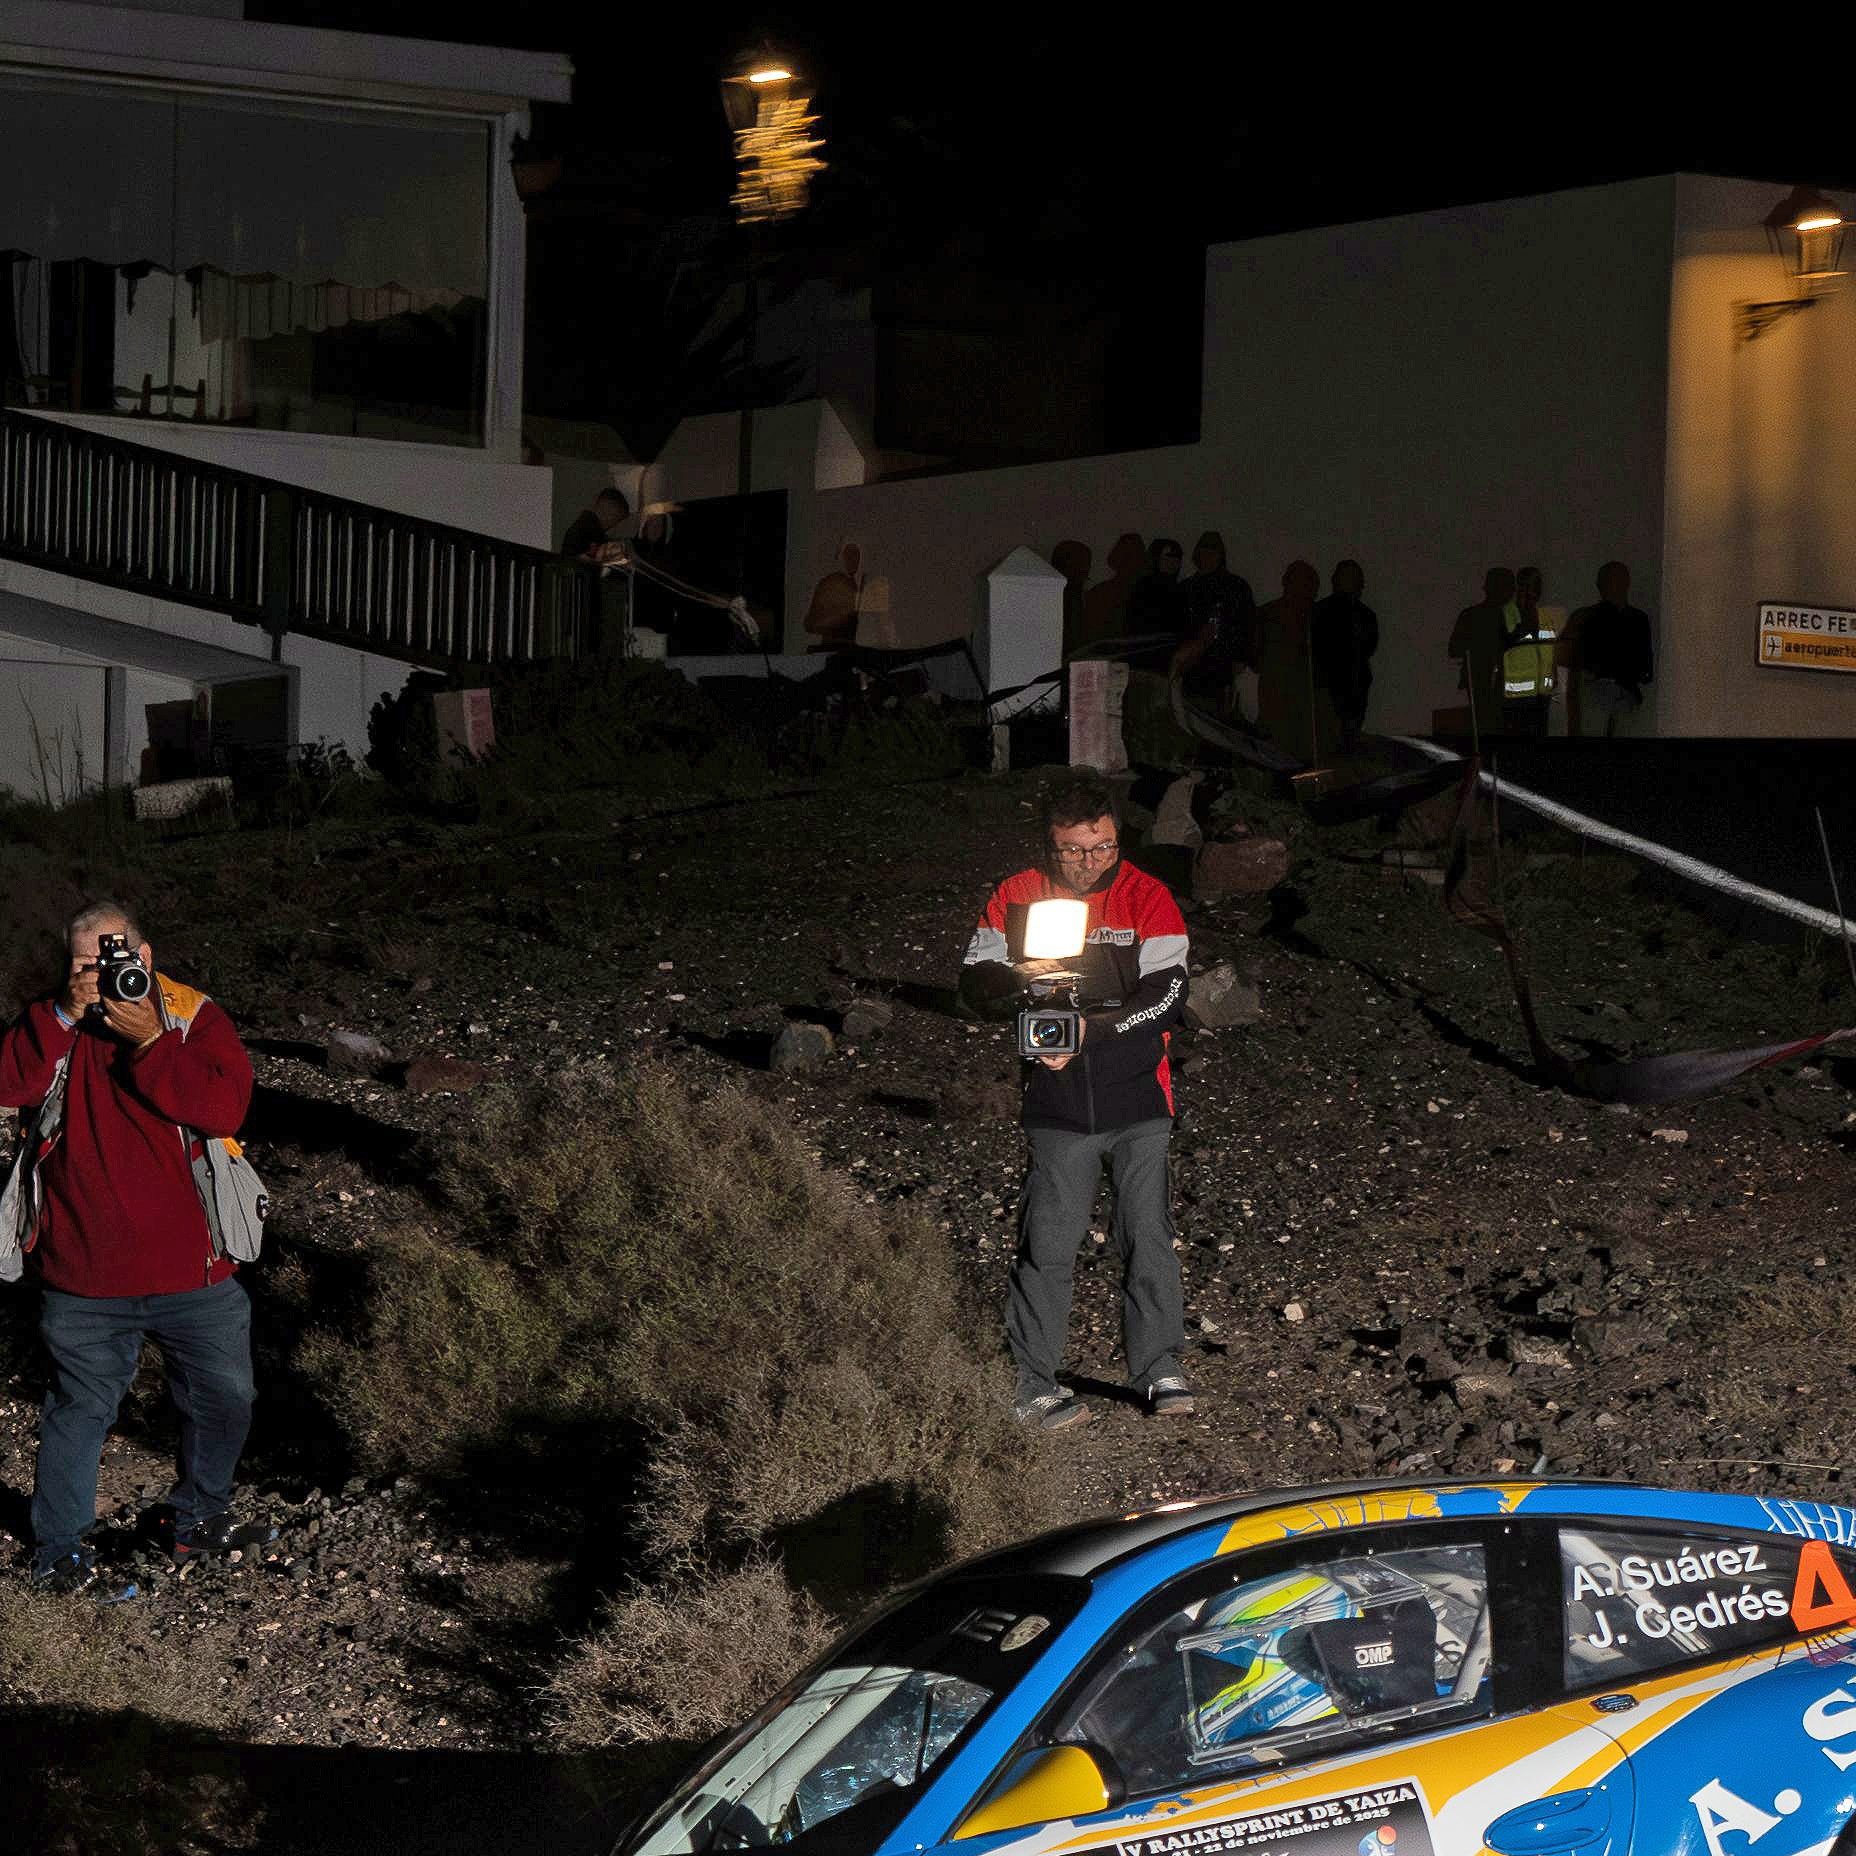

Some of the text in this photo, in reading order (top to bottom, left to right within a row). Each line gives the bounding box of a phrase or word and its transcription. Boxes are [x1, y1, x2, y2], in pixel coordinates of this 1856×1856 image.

[1573, 1544, 1767, 1601] A. Suárez
[1588, 1585, 1790, 1649] J. Cedrés
[1355, 1645, 1393, 1666] OMP
[1147, 1811, 1305, 1856] RALLYSPRINT
[1309, 1804, 1344, 1821] DE
[1344, 1787, 1418, 1814] YAIZA
[1204, 1842, 1224, 1854] 22
[1228, 1837, 1245, 1849] de
[1247, 1819, 1330, 1846] noviembre
[1333, 1814, 1351, 1826] de
[1354, 1807, 1392, 1822] 2025
